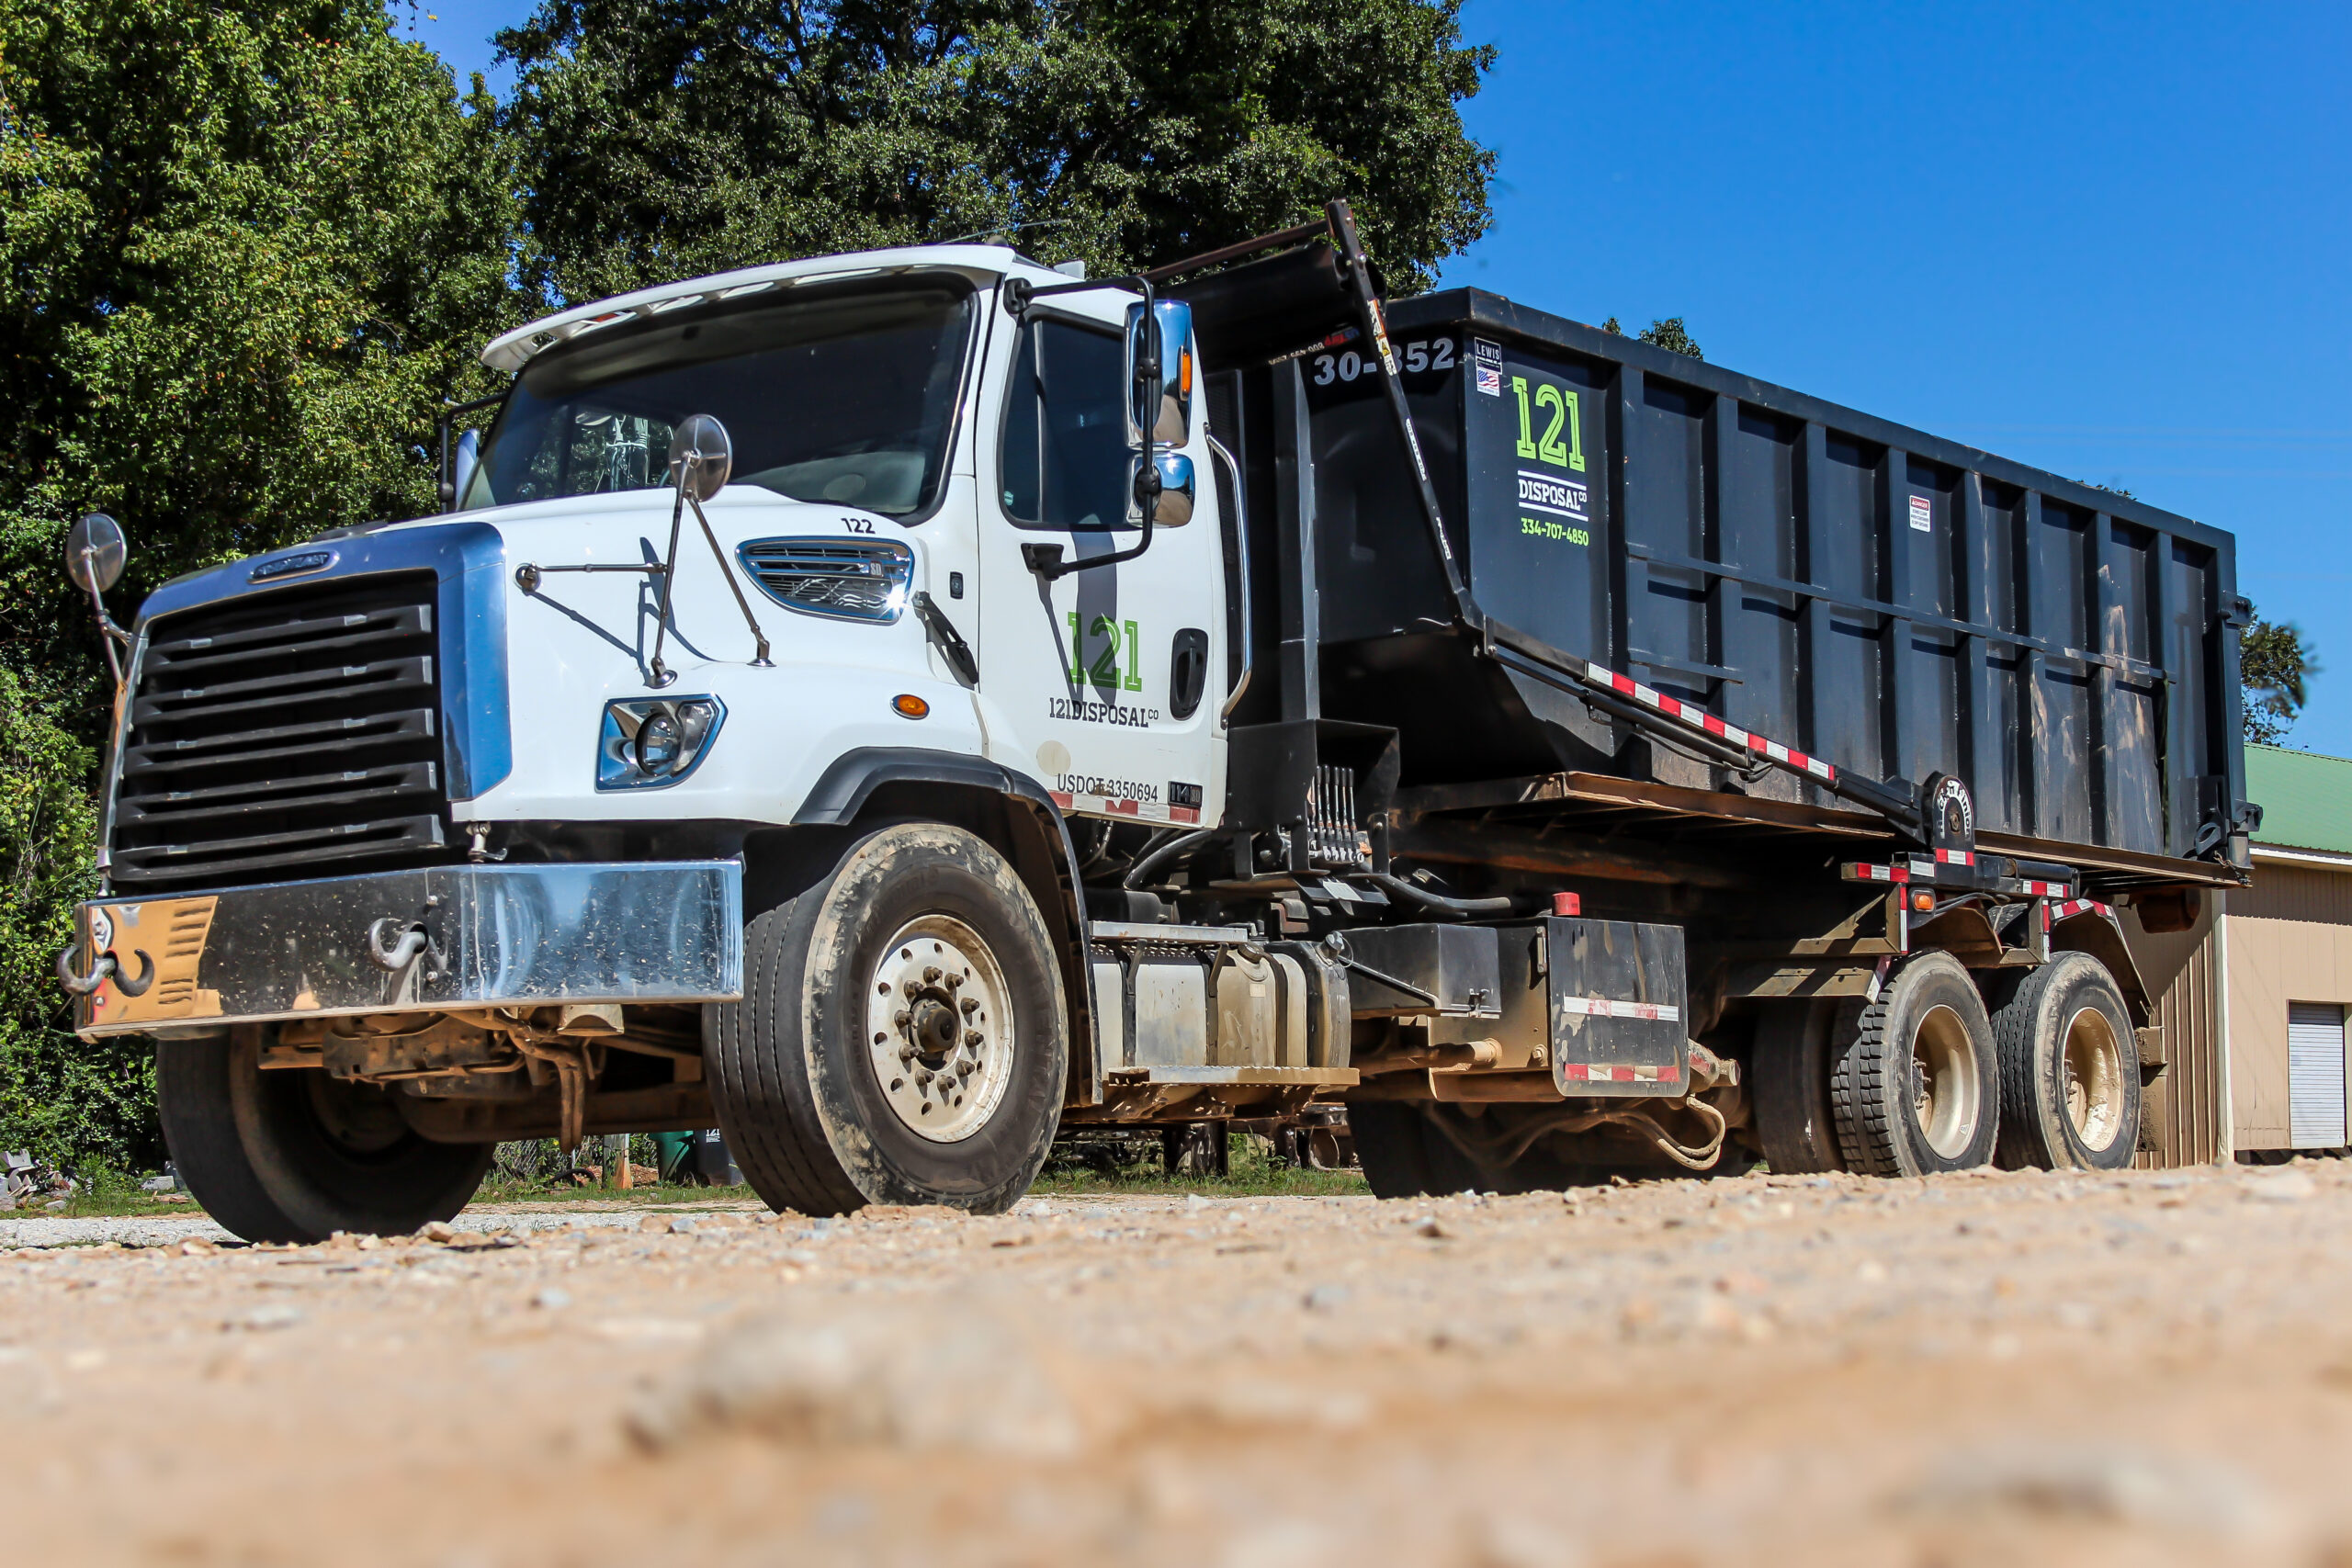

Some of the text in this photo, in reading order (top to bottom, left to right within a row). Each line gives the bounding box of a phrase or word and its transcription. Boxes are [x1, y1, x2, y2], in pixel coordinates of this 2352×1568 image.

[1476, 343, 1500, 360] LEWIS
[1511, 376, 1586, 473] 121
[1519, 479, 1581, 511] DISPOSAL
[841, 517, 876, 535] 122
[1521, 517, 1589, 547] 334-707-4850
[870, 562, 882, 576] SD
[1068, 612, 1142, 692] 121
[1057, 773, 1159, 803] USDOT 3350694
[1170, 784, 1201, 803] 114 SD
